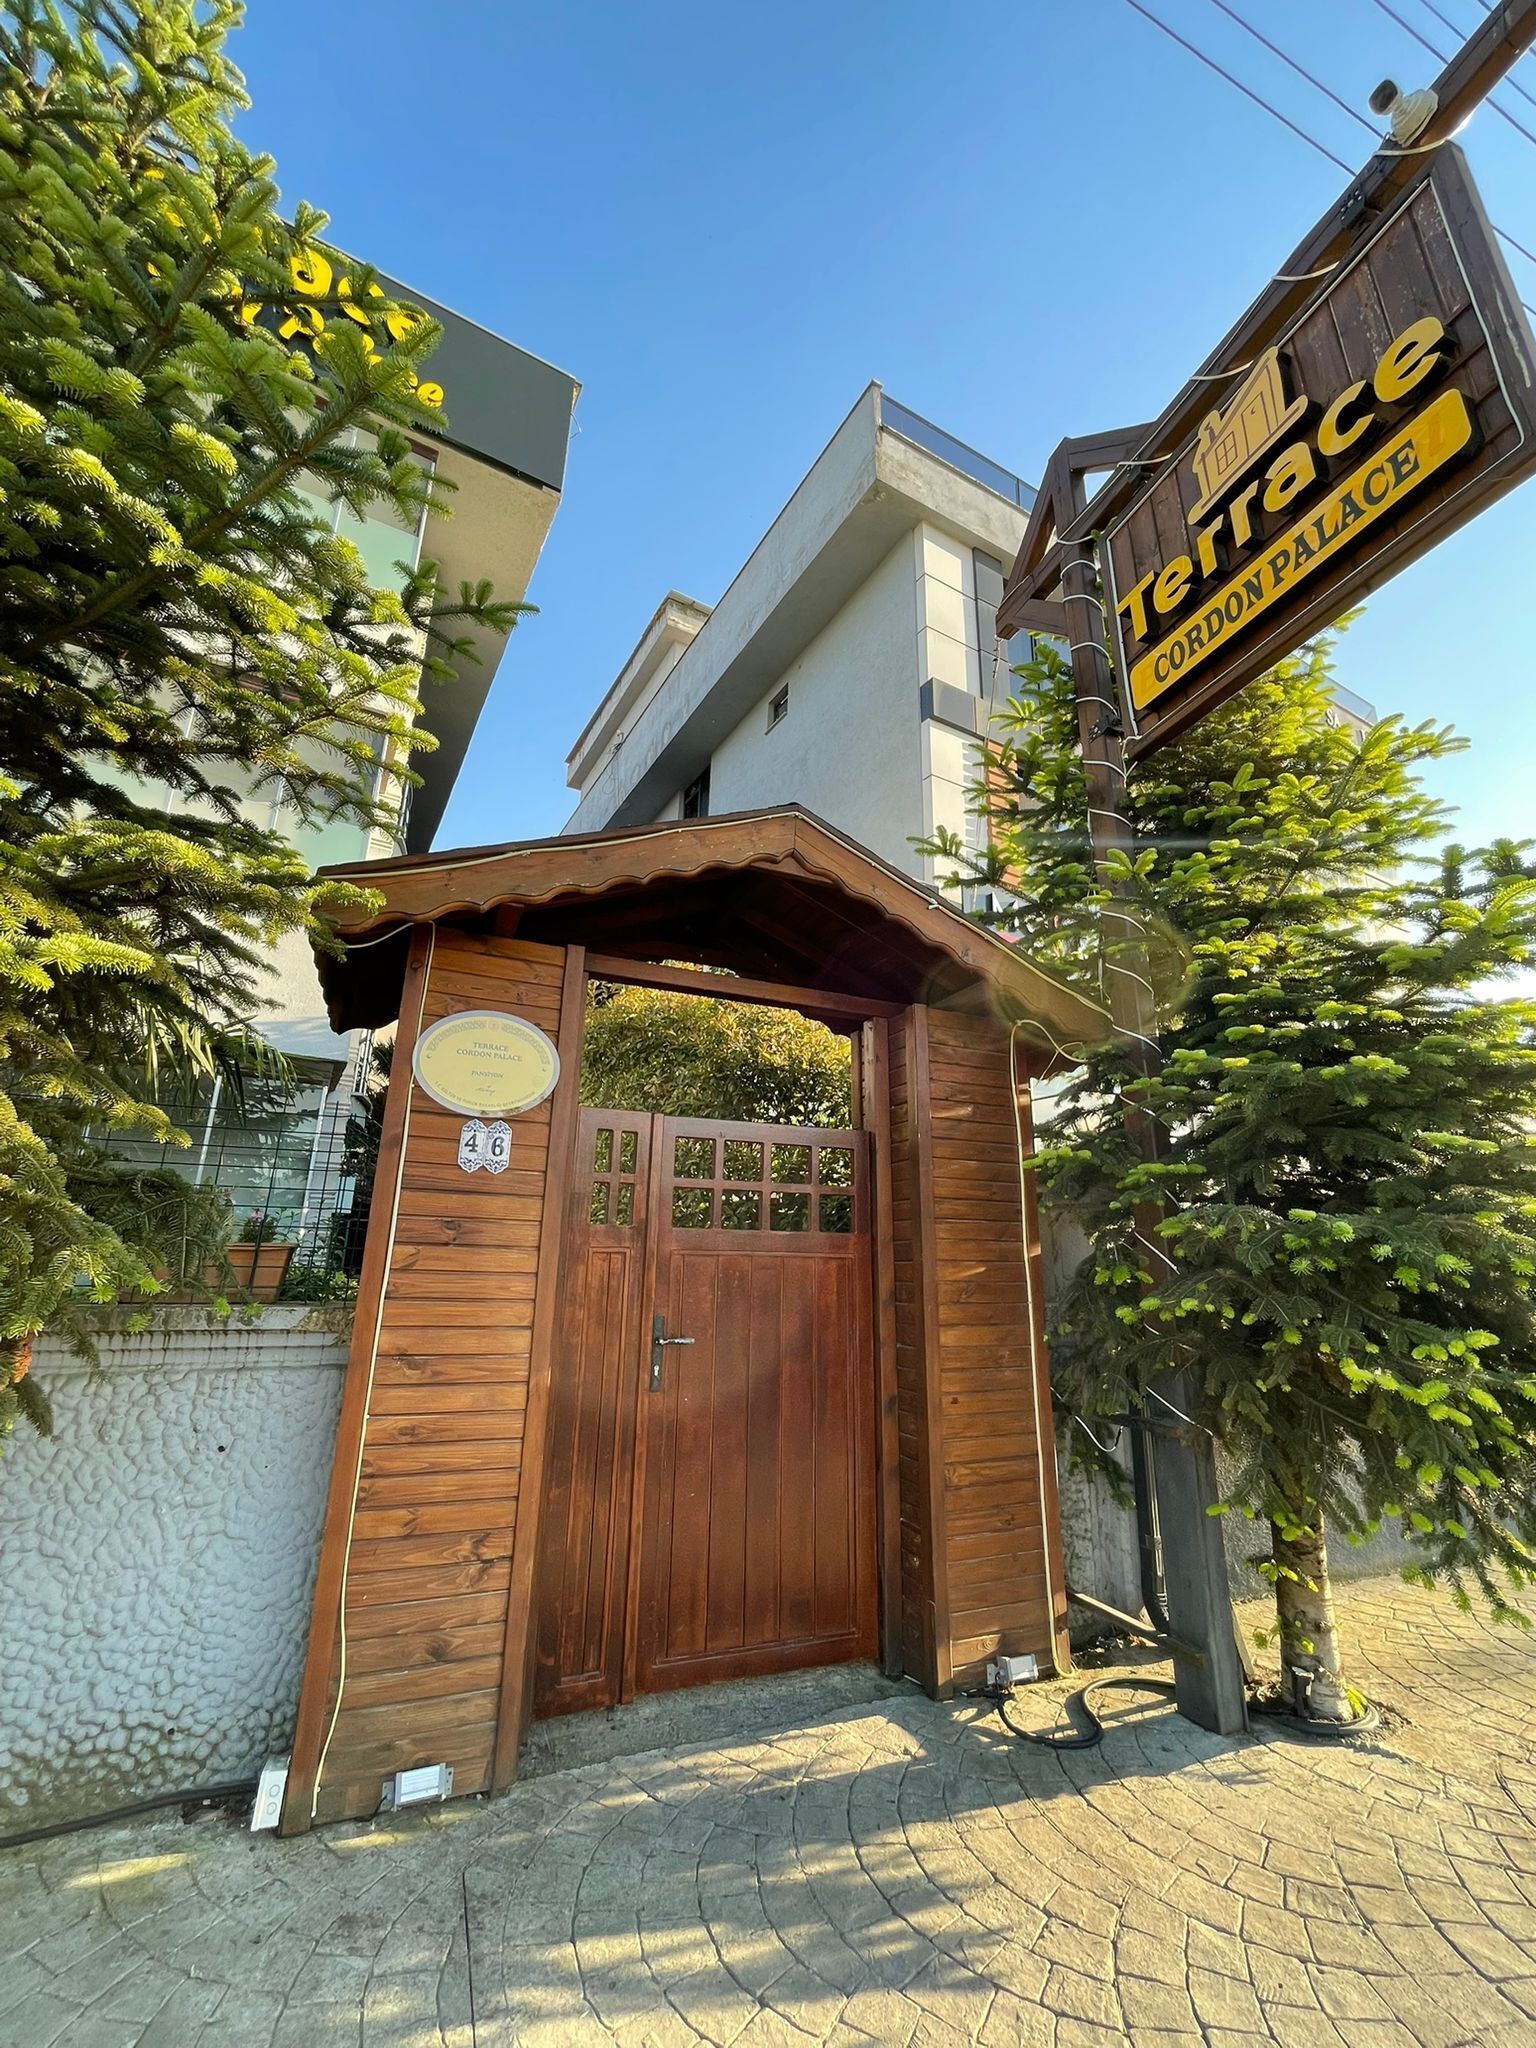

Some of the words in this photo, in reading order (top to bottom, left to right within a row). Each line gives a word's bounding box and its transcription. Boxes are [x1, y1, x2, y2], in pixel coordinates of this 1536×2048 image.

[1116, 316, 1445, 642] Terrace
[1154, 557, 1264, 683] CORDON
[1271, 438, 1421, 586] PALACE
[456, 1048, 492, 1059] CORDON
[493, 1052, 523, 1062] PALACE
[473, 1041, 509, 1052] TERRACE
